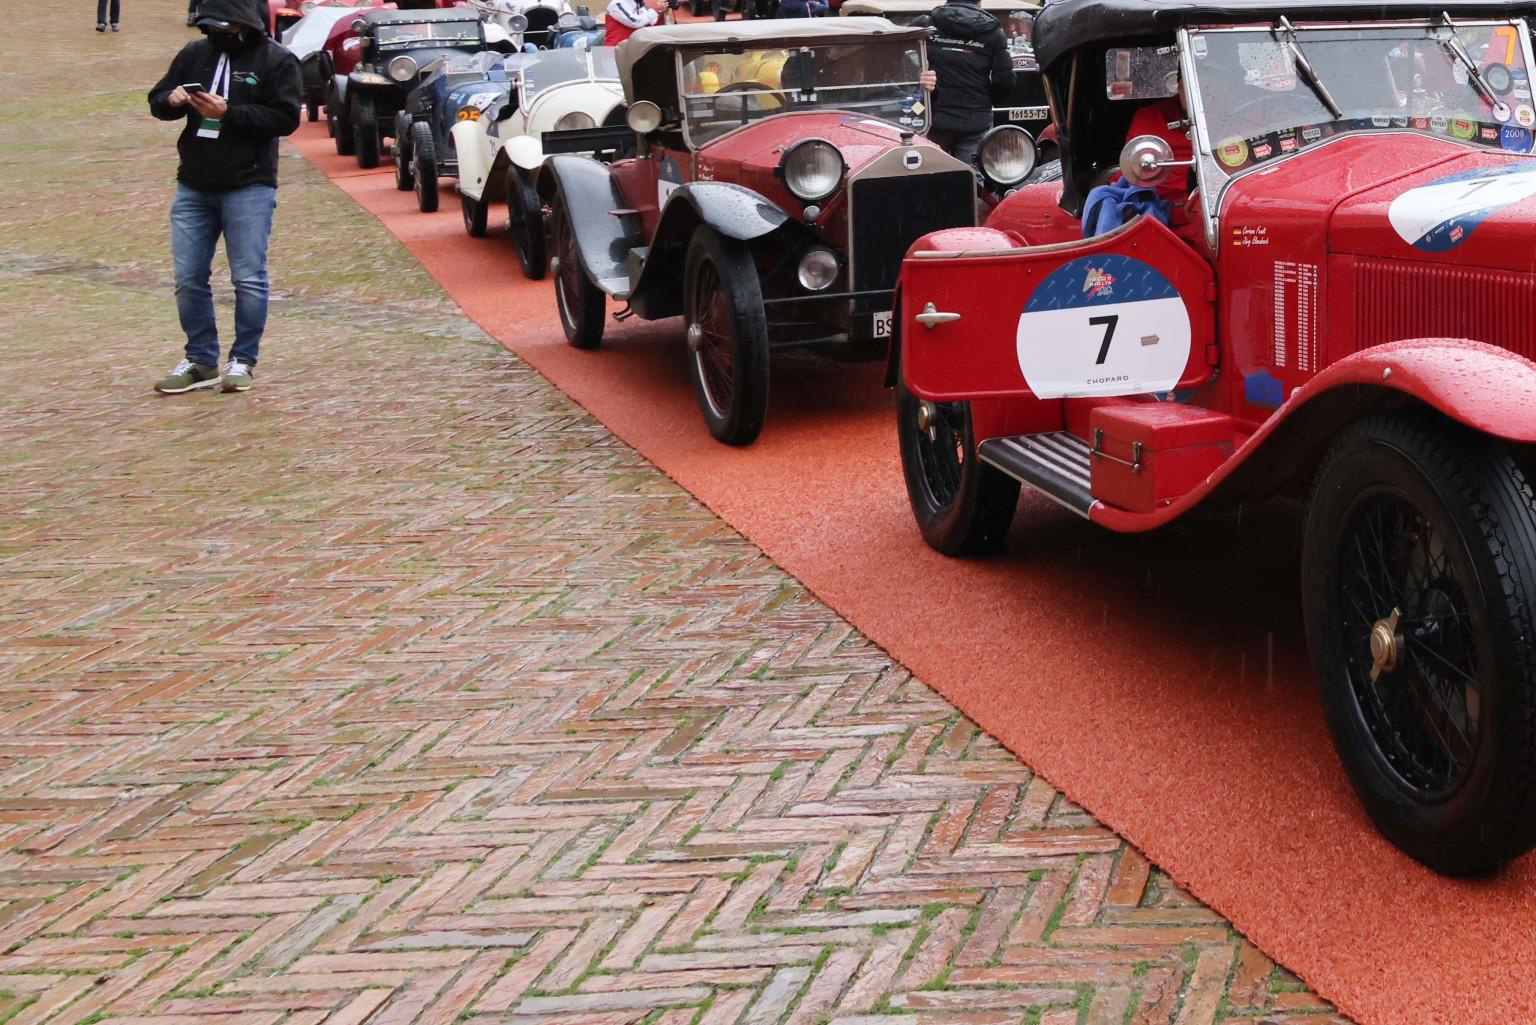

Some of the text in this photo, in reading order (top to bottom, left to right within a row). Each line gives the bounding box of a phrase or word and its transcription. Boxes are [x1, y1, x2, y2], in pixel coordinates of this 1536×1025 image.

[1494, 28, 1517, 65] 7
[1504, 129, 1526, 139] 2008
[1089, 314, 1119, 365] 7
[1087, 375, 1129, 385] CHOPARD
